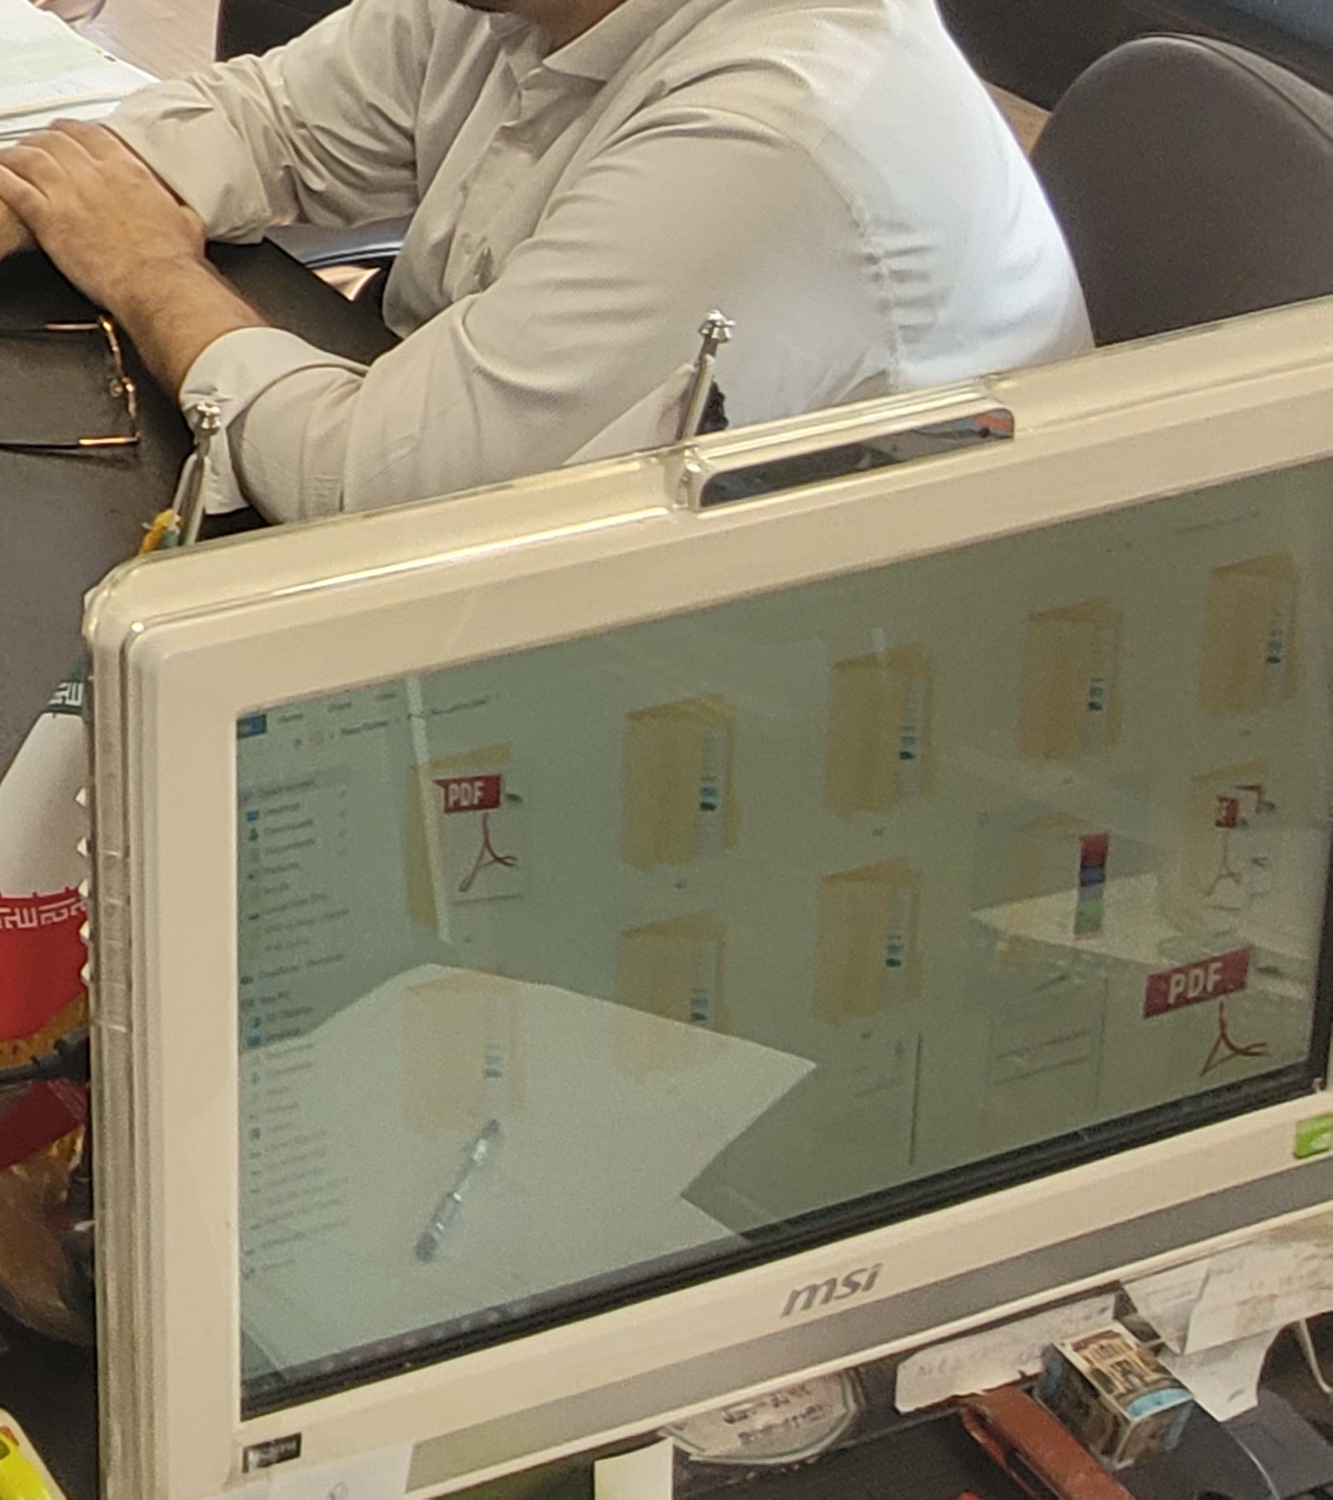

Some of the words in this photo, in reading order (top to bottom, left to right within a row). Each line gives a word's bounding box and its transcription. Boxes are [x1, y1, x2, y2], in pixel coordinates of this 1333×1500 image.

[446, 781, 486, 808] PDF
[1167, 961, 1224, 1006] PDF
[780, 1263, 883, 1318] msi
